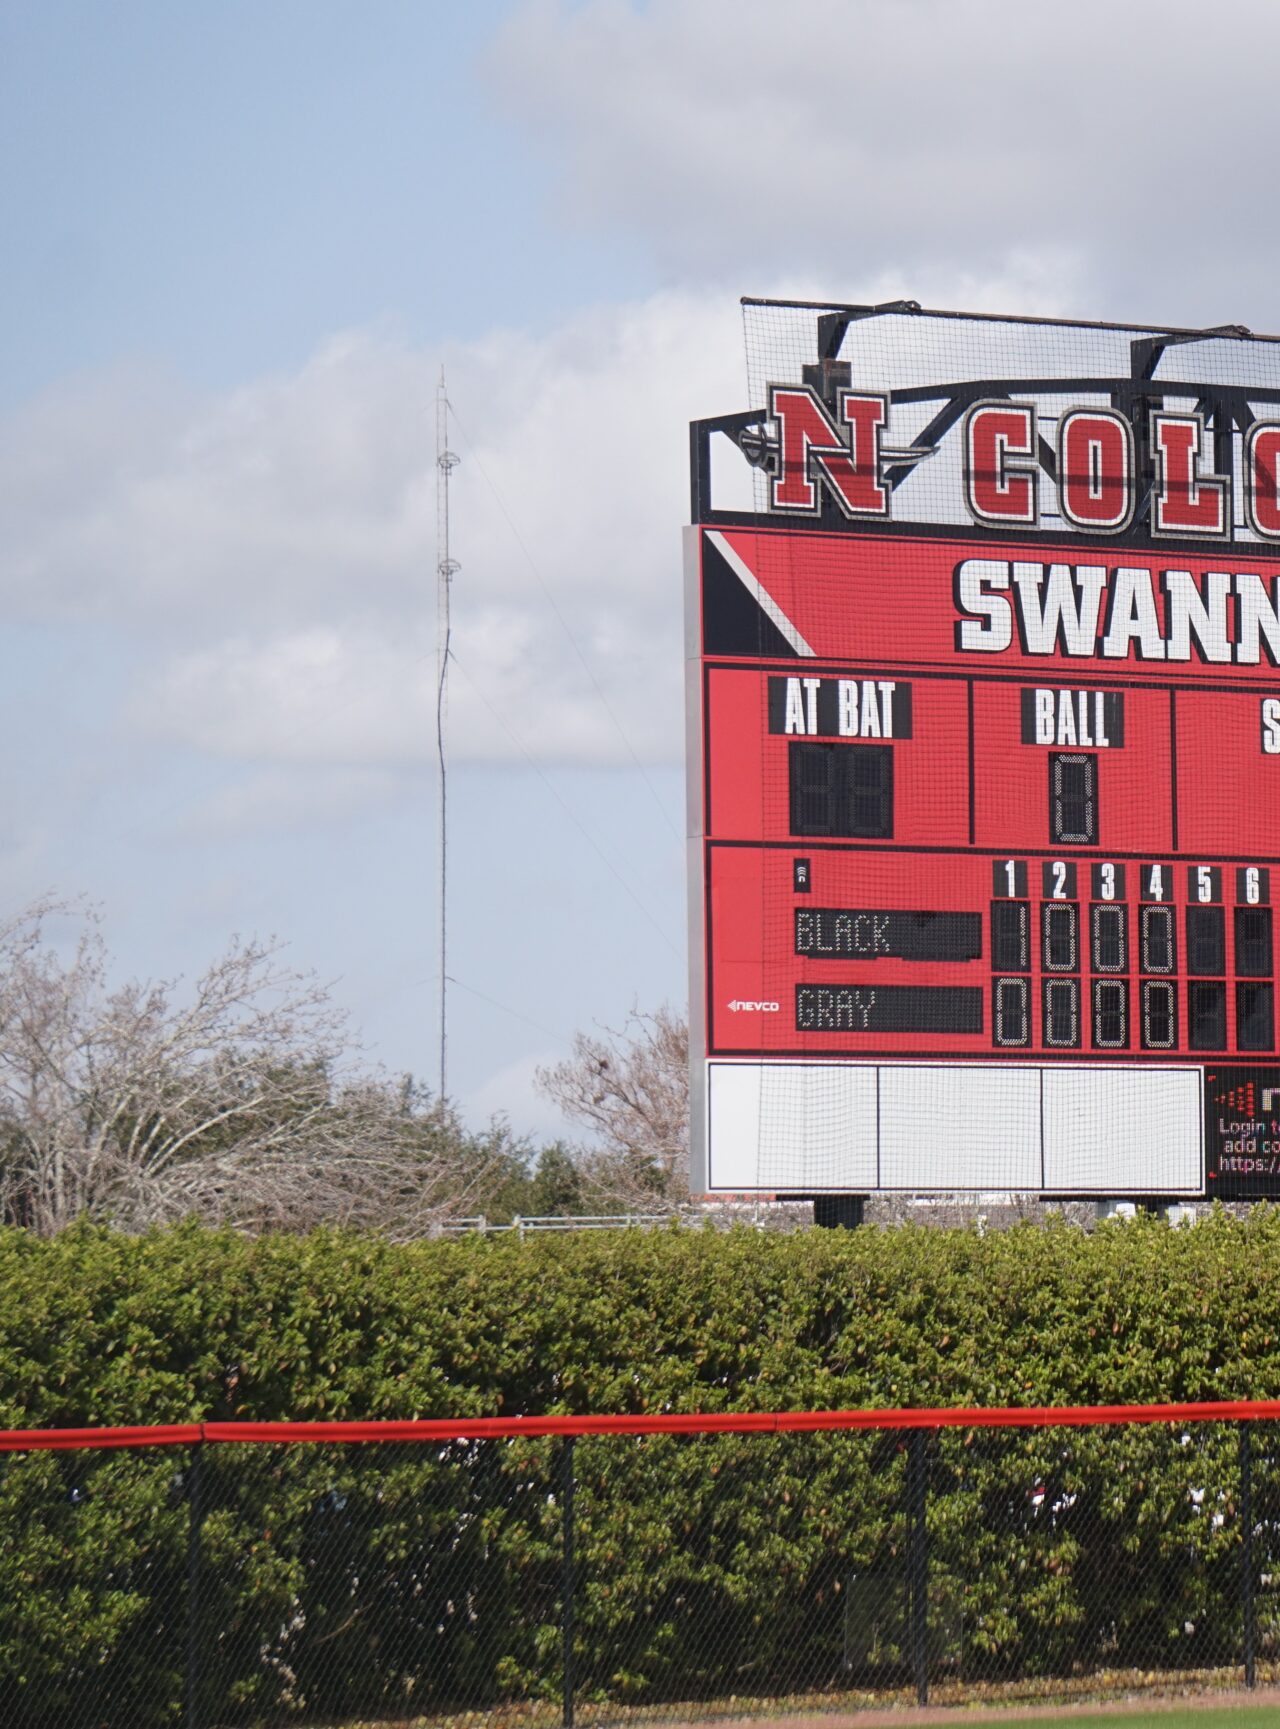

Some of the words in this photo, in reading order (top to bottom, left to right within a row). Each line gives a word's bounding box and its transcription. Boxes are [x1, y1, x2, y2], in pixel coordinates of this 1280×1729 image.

[767, 382, 893, 520] N
[785, 677, 821, 735] AT
[838, 680, 896, 738] BAT
[1035, 689, 1110, 748] BALL
[1055, 754, 1093, 843] 0
[1005, 860, 1016, 898] 1
[1052, 862, 1067, 900] 2
[1101, 863, 1116, 901] 3
[1149, 864, 1164, 902] 4
[1197, 866, 1212, 903] 5
[1245, 867, 1260, 904] 6
[797, 912, 891, 952] BLACK
[1019, 905, 1027, 967] 1
[1045, 903, 1076, 972] 0
[1094, 904, 1125, 972] 0
[1142, 906, 1173, 973] 0
[798, 989, 876, 1028] GRAY
[997, 978, 1028, 1046] 0
[1046, 979, 1077, 1047] 0
[1095, 980, 1126, 1047] 0
[1144, 981, 1175, 1048] 0
[1219, 1118, 1266, 1138] Login
[1224, 1137, 1257, 1154] add
